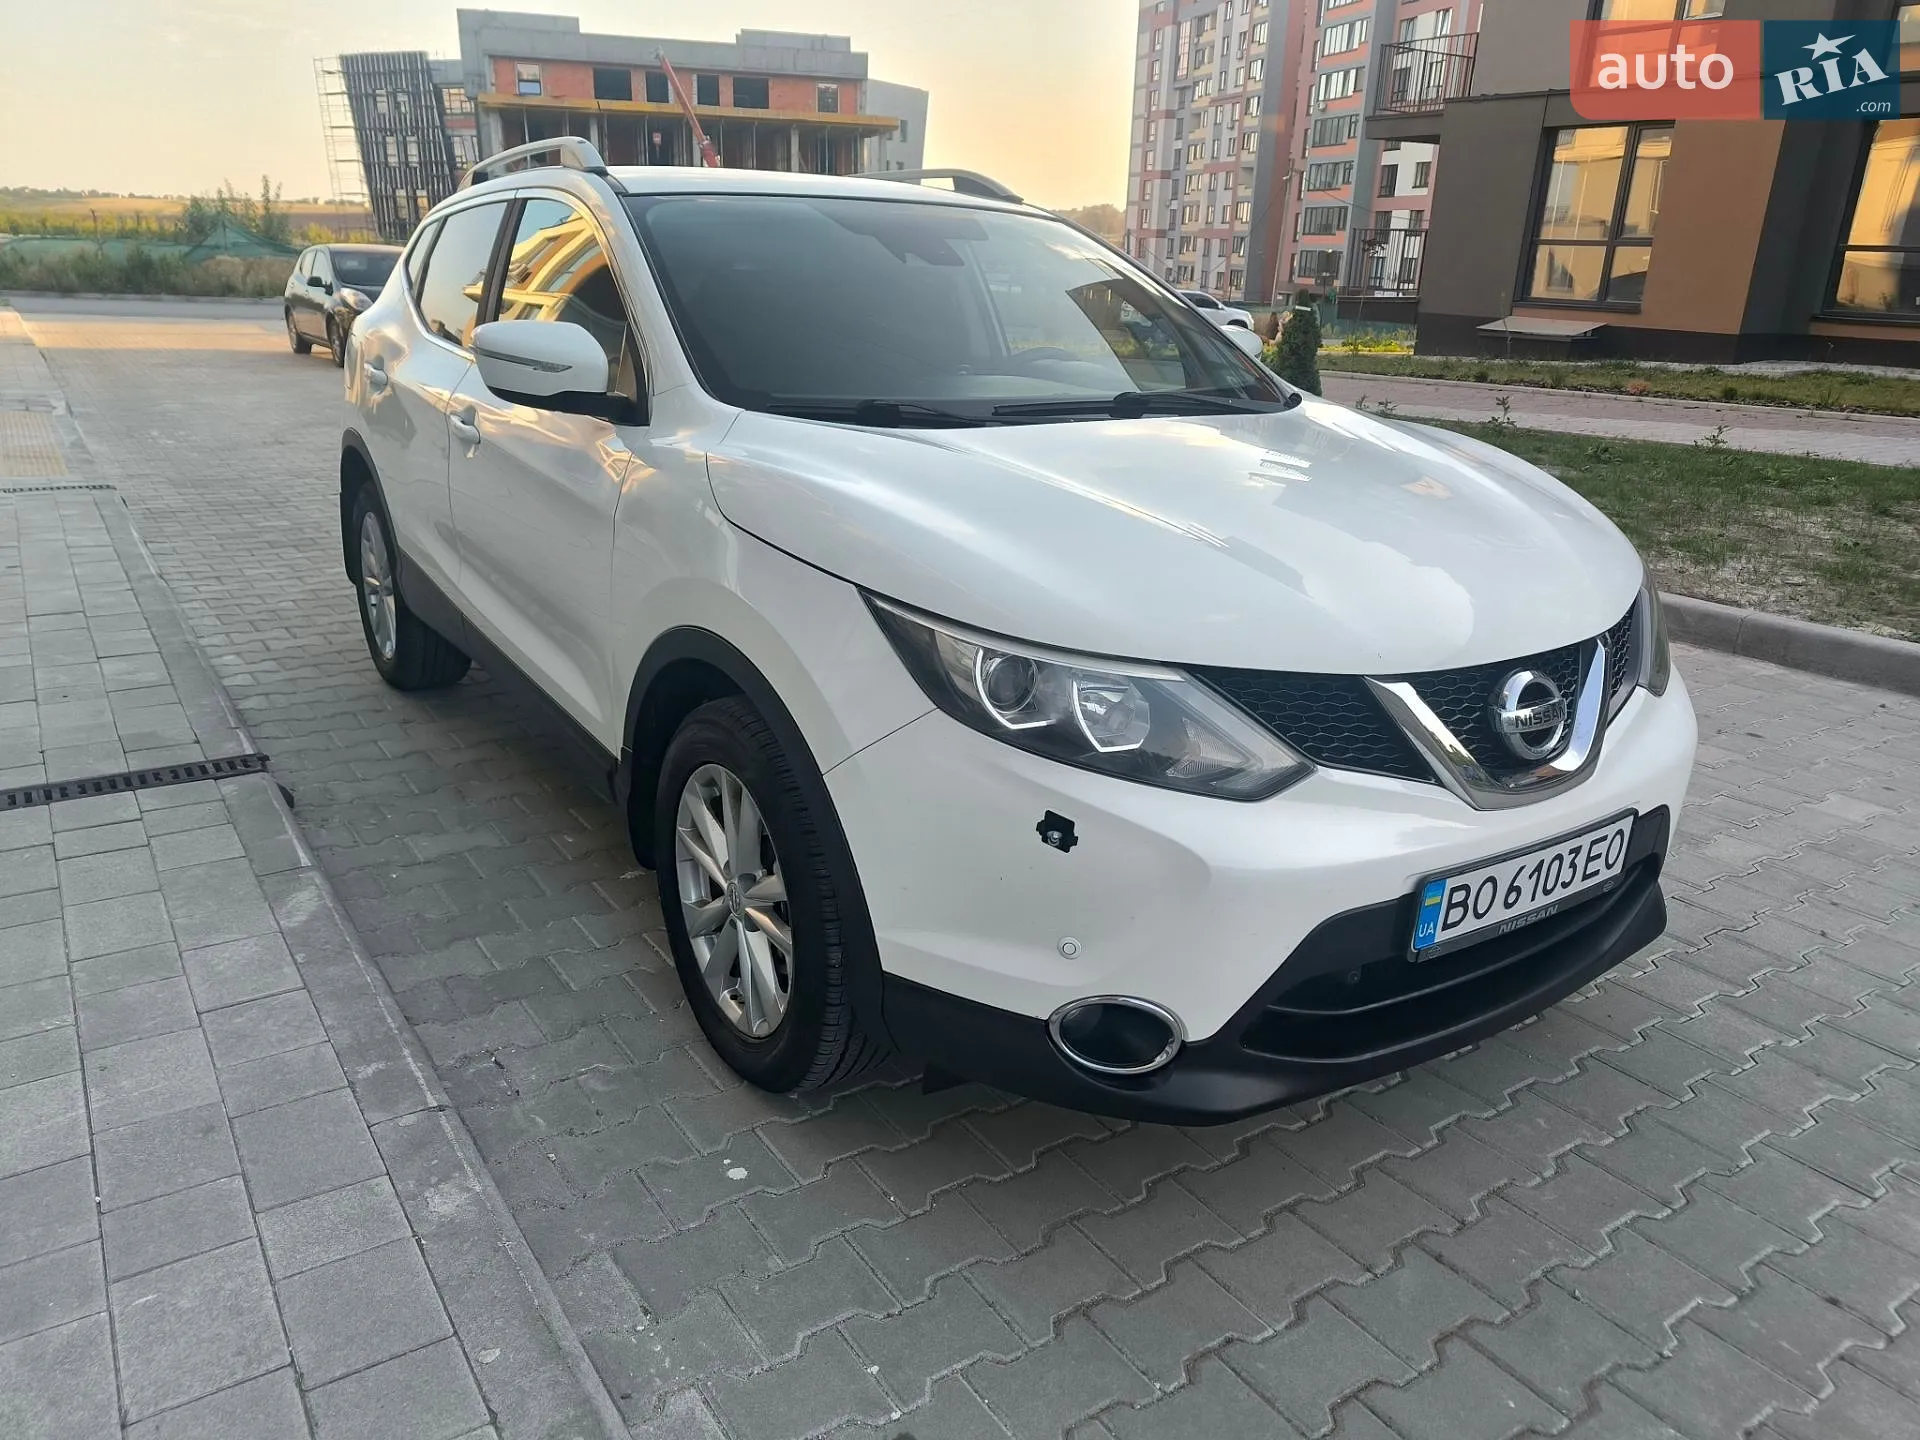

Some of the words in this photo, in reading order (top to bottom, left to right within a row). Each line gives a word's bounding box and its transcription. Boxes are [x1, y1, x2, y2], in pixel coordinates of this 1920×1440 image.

[1514, 706, 1567, 729] NISSAN
[1418, 921, 1434, 937] UA
[1499, 904, 1559, 934] NISSAN
